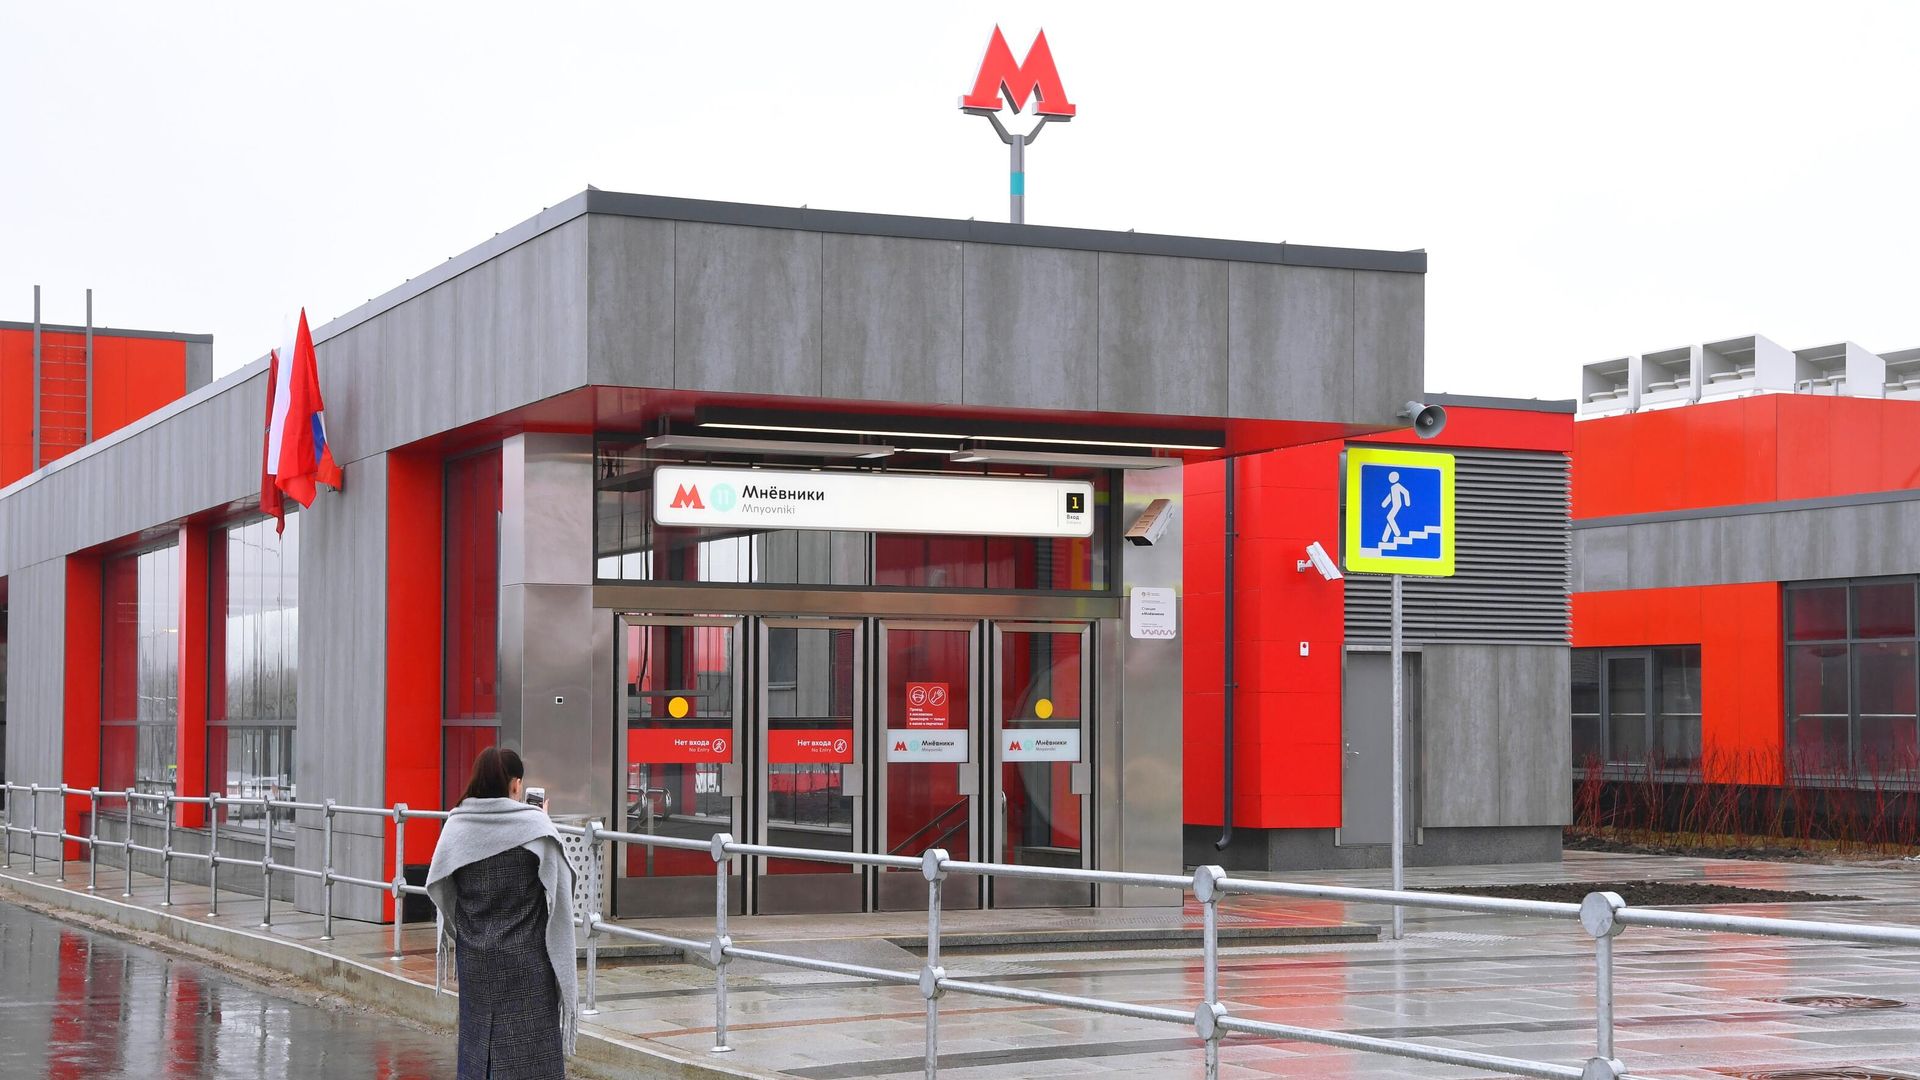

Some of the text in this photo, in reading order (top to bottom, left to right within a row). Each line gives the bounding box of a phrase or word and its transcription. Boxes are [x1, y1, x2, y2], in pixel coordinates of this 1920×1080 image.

[717, 489, 730, 505] 11
[742, 485, 825, 501] Мнёвники
[742, 504, 796, 515] Mnyovniki
[1072, 496, 1079, 509] 1
